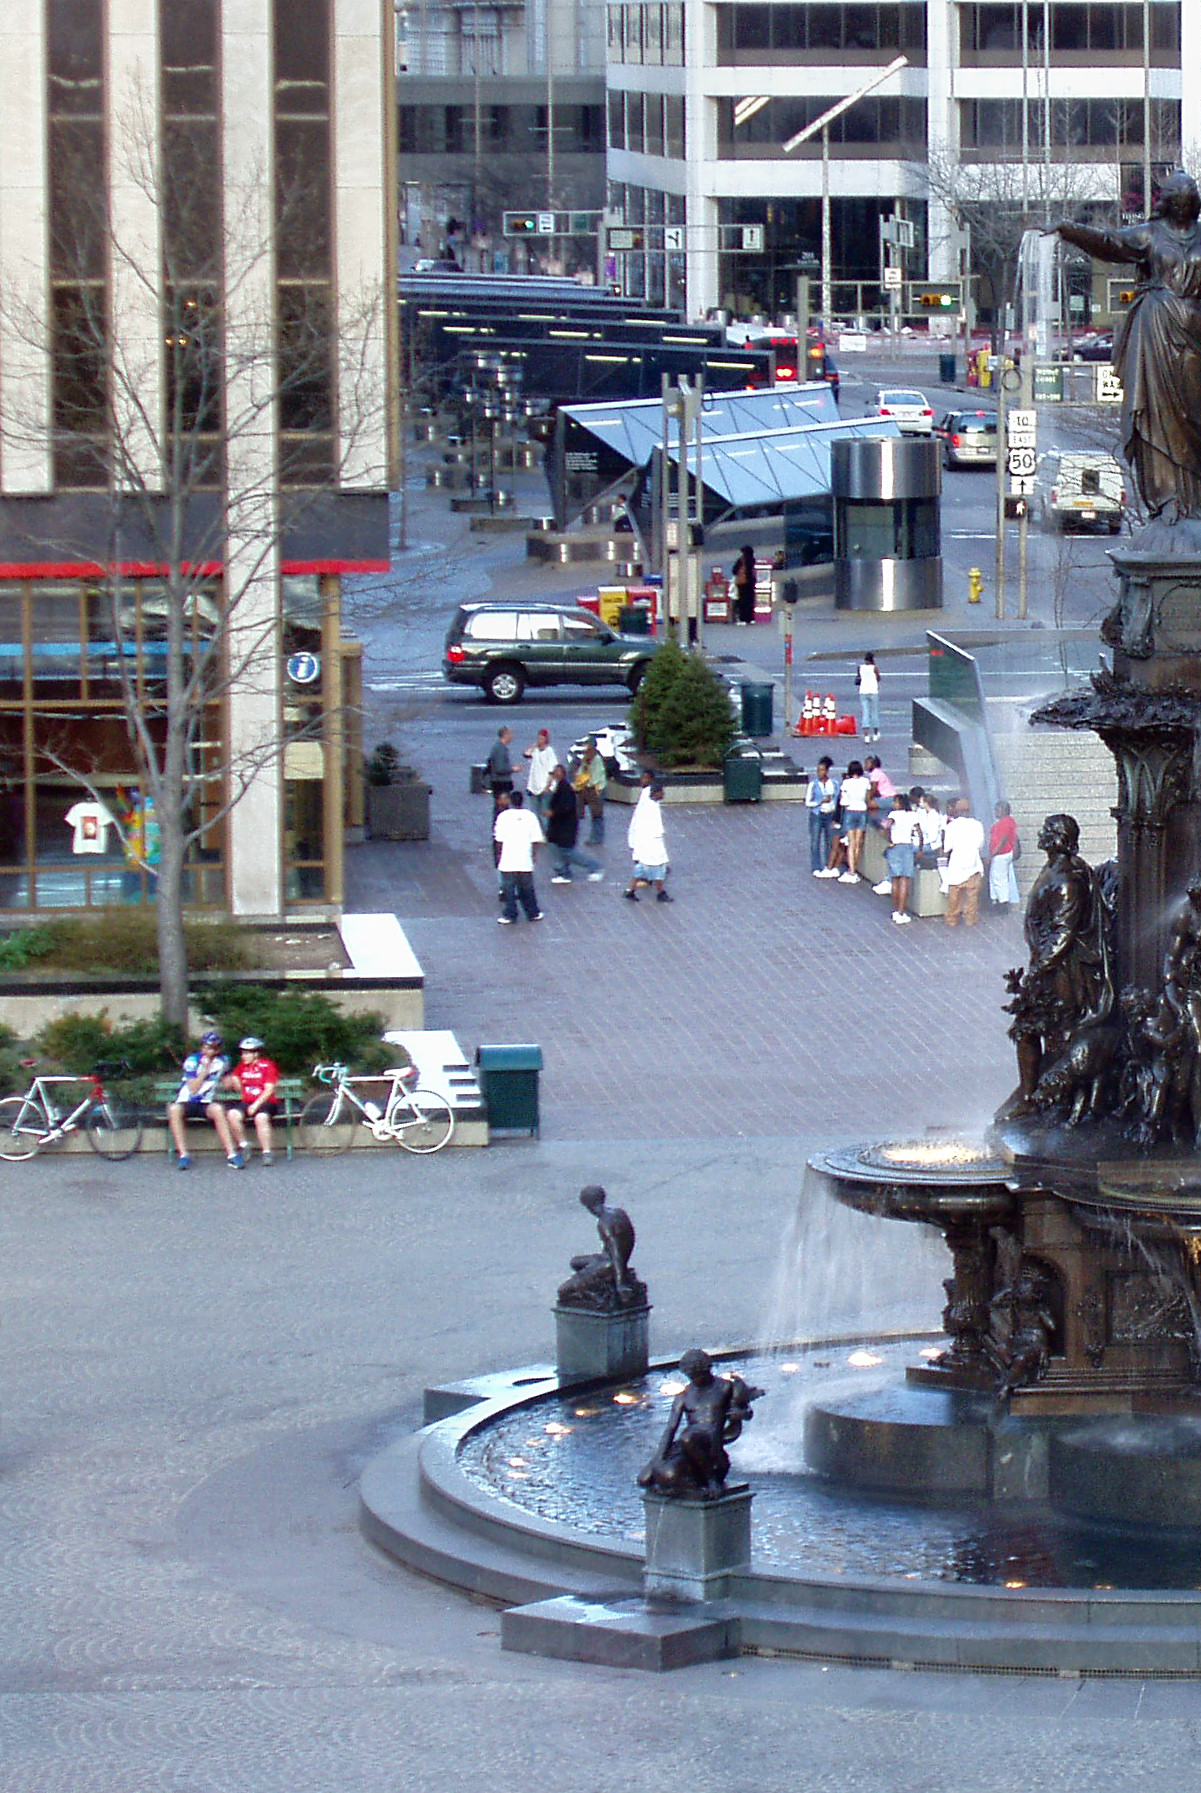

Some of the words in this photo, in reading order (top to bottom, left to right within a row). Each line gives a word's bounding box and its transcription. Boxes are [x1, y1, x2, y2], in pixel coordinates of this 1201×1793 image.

[1016, 416, 1029, 427] TO
[1013, 436, 1032, 444] EAST
[1012, 453, 1033, 470] 50
